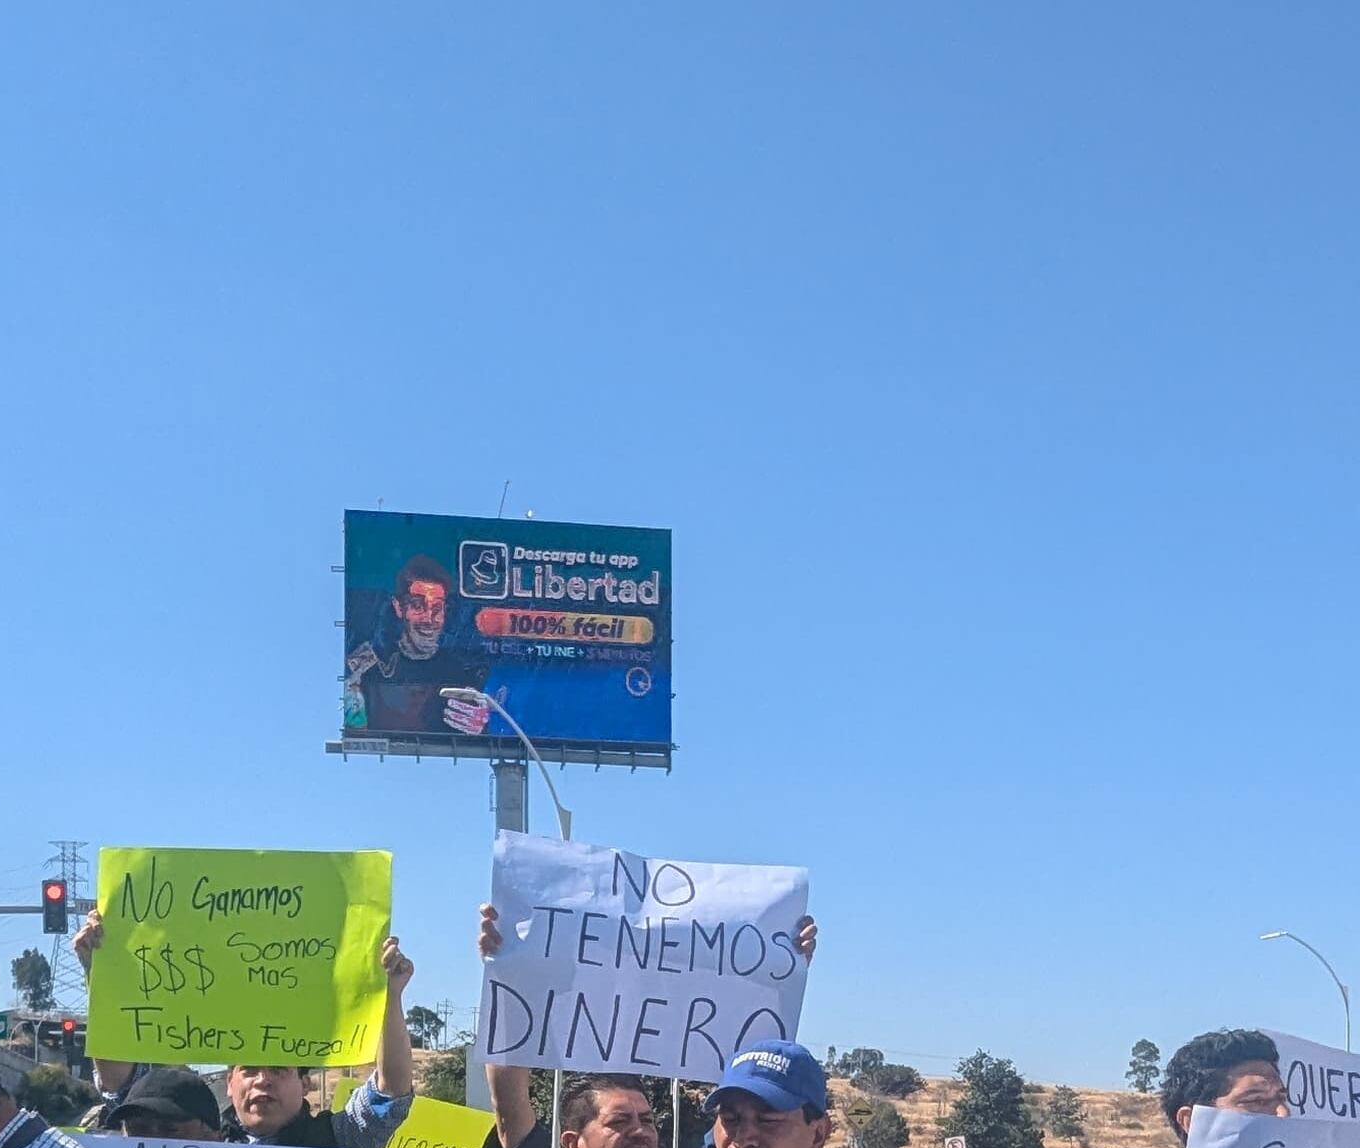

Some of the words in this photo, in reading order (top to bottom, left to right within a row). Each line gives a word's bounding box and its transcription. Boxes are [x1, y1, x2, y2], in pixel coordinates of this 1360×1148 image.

[513, 547, 586, 566] Descarga
[590, 552, 606, 564] tu
[609, 555, 639, 568] app
[512, 564, 660, 605] Libertad
[510, 613, 567, 635] 100%
[573, 616, 625, 638] fácil
[535, 645, 551, 657] TU
[191, 876, 304, 921] Ganamos
[611, 852, 696, 906] NO
[226, 932, 337, 963] Somos
[533, 906, 797, 981] TENEMOS
[134, 942, 216, 1001] $$$
[487, 978, 787, 1073] DINERO
